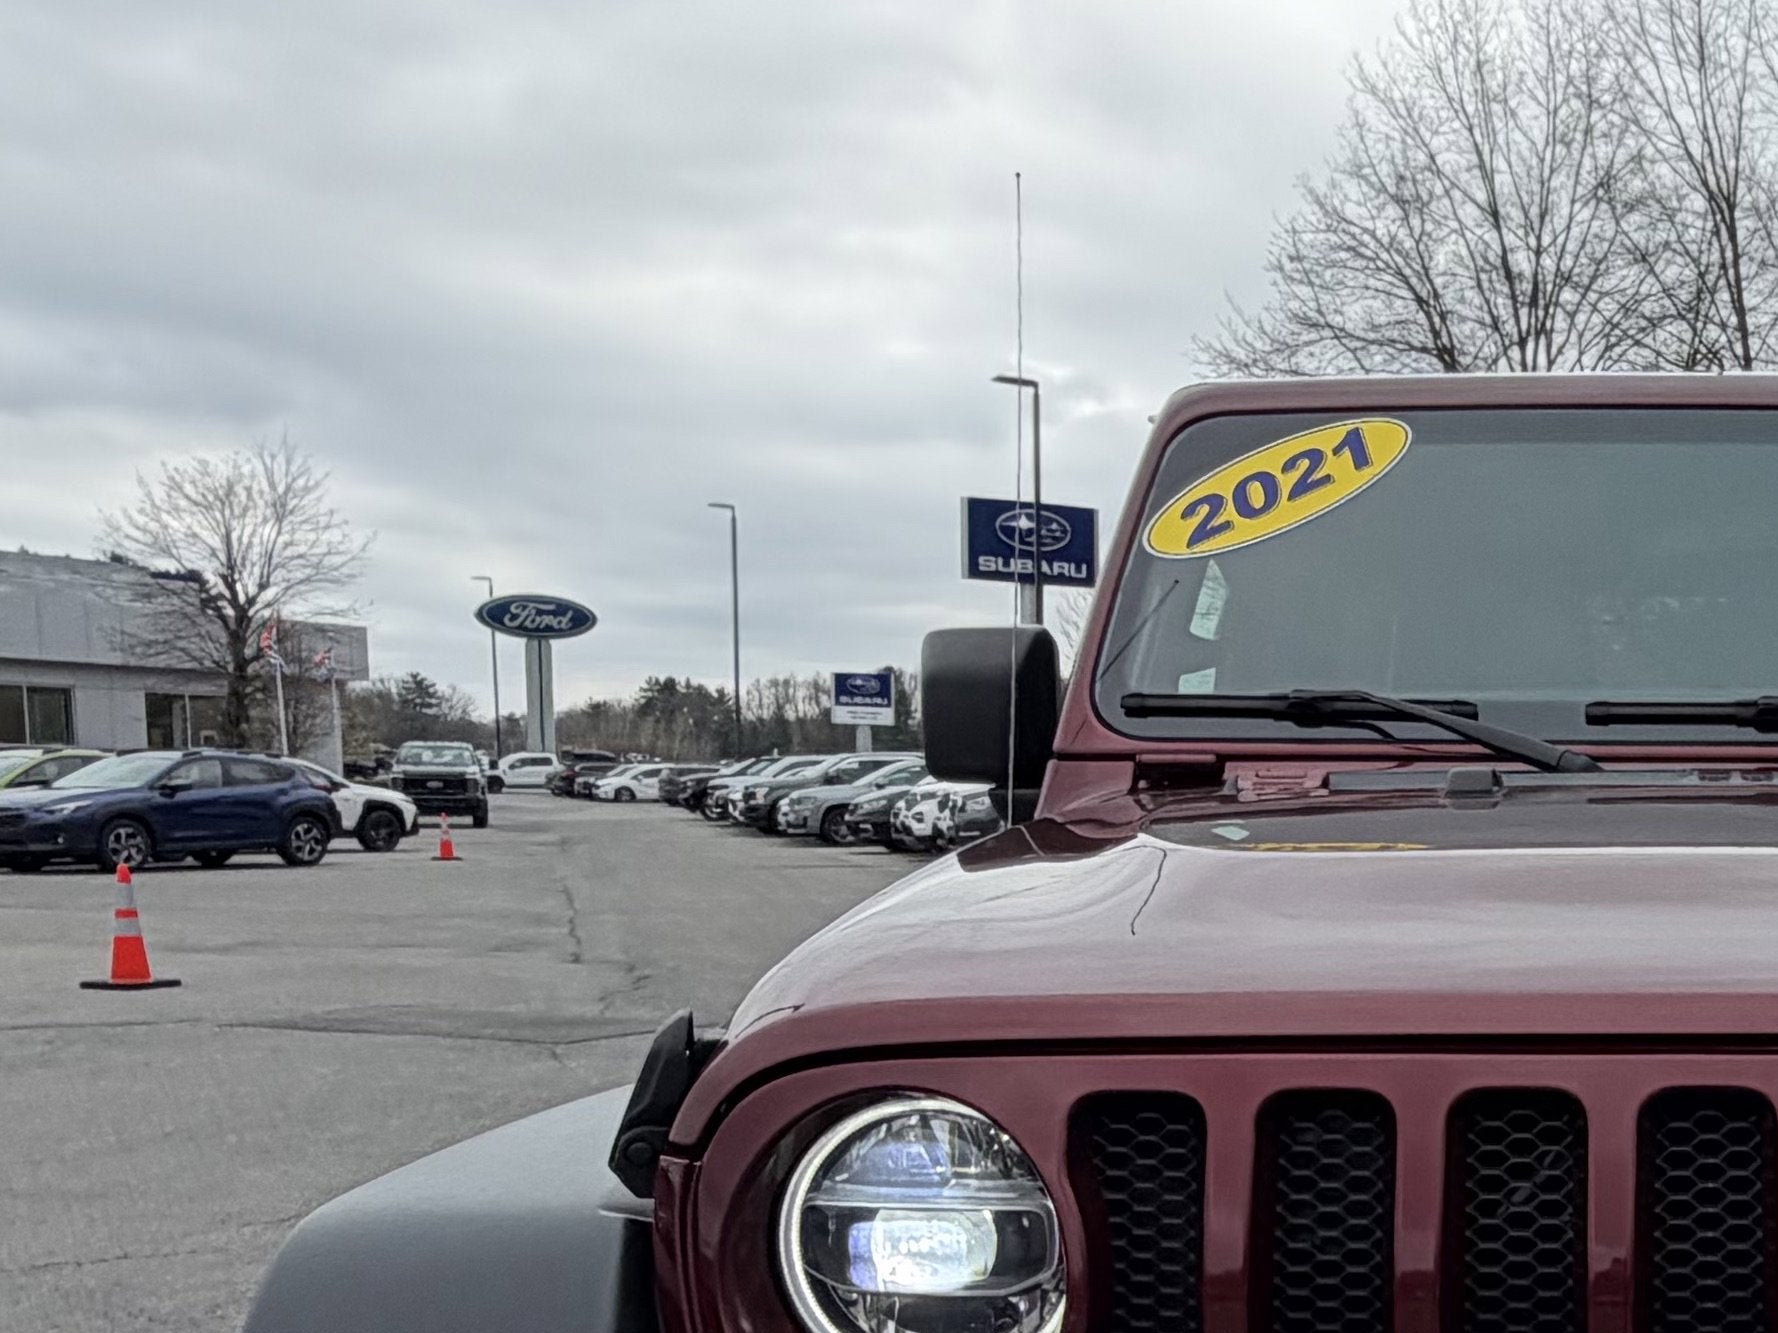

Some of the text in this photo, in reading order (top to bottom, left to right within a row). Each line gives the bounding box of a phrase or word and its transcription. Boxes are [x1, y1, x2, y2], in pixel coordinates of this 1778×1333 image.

[1180, 426, 1374, 549] 2021
[978, 555, 1087, 579] SUBARU
[503, 601, 573, 629] Ford
